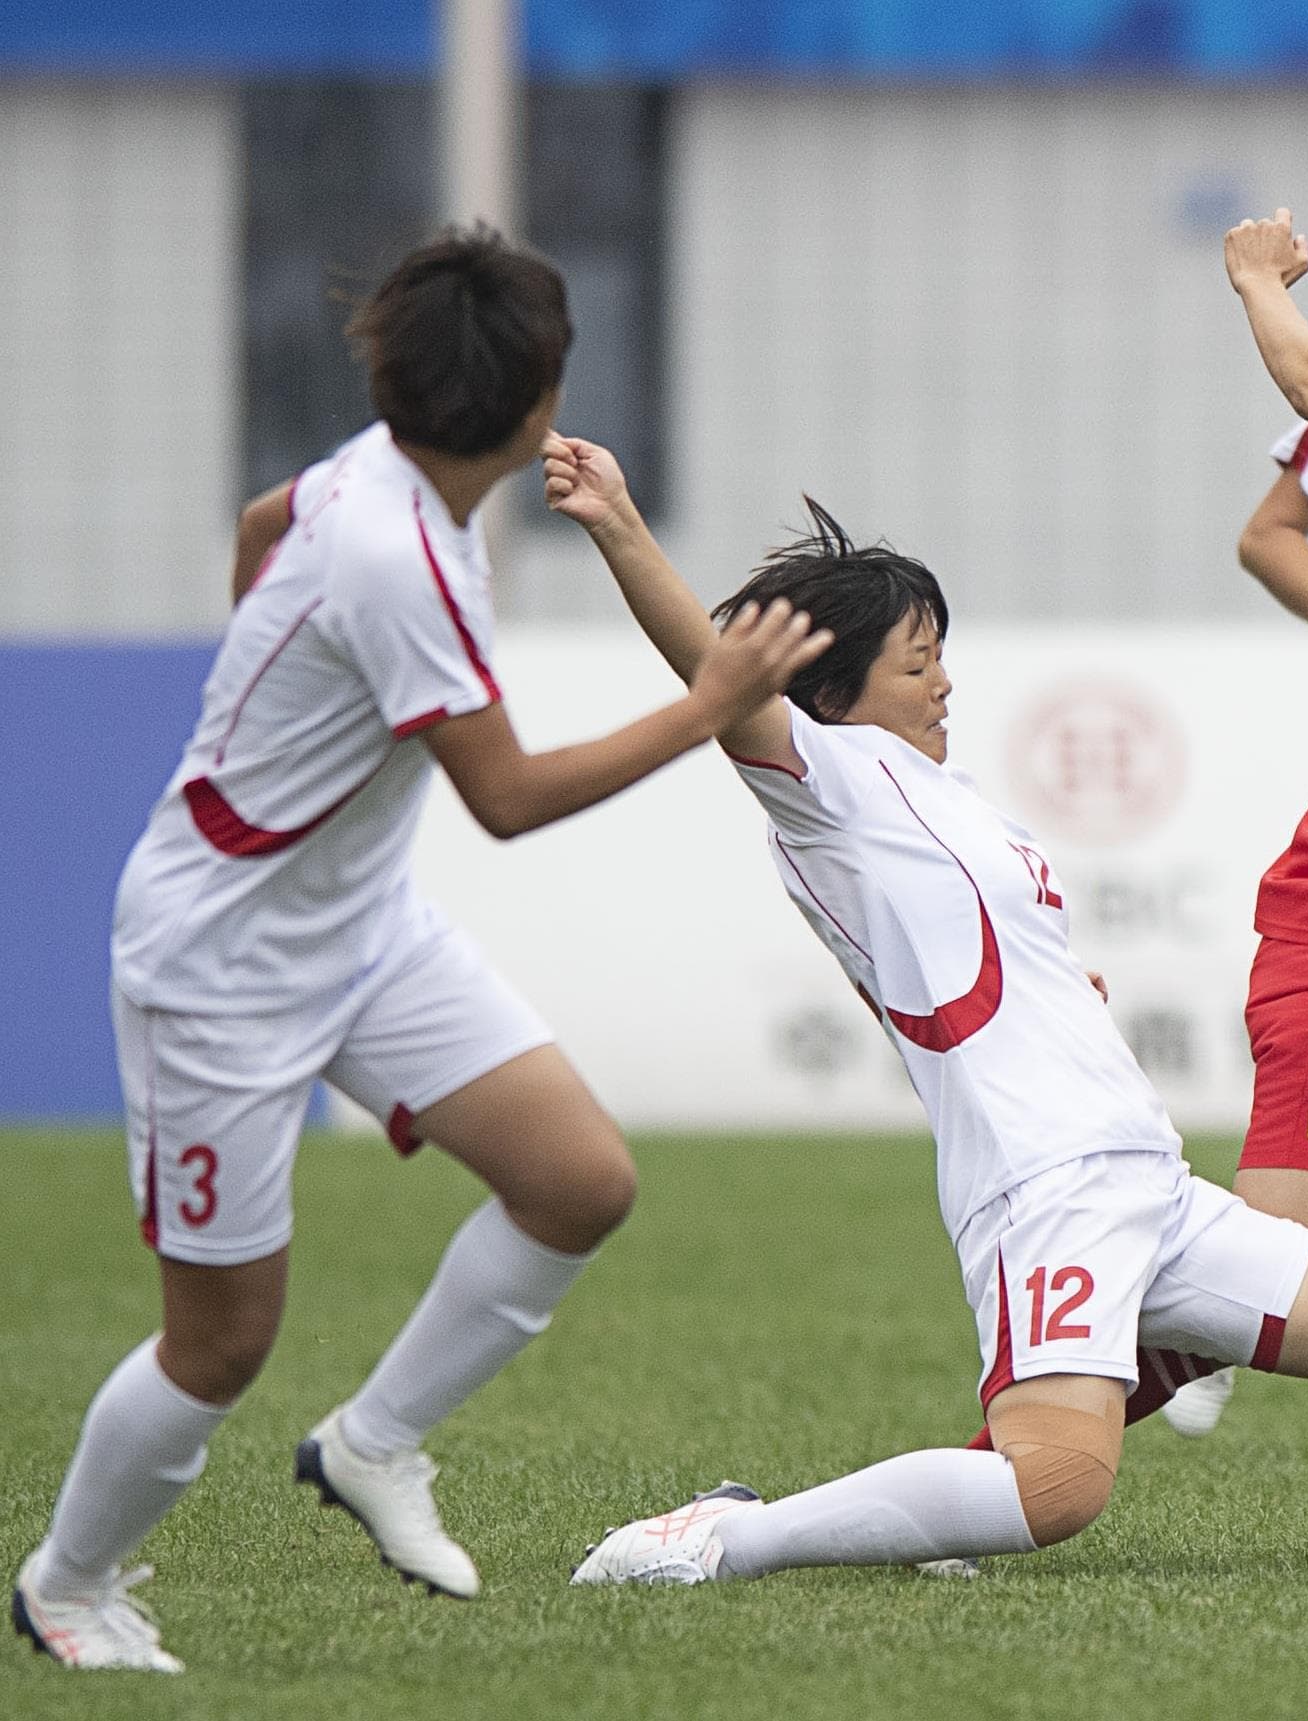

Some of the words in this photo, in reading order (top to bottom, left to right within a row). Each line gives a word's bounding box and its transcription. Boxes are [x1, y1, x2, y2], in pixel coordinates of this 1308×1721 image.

[1006, 840, 1063, 911] 12
[178, 1143, 217, 1229] 3
[1025, 1265, 1095, 1347] 12
